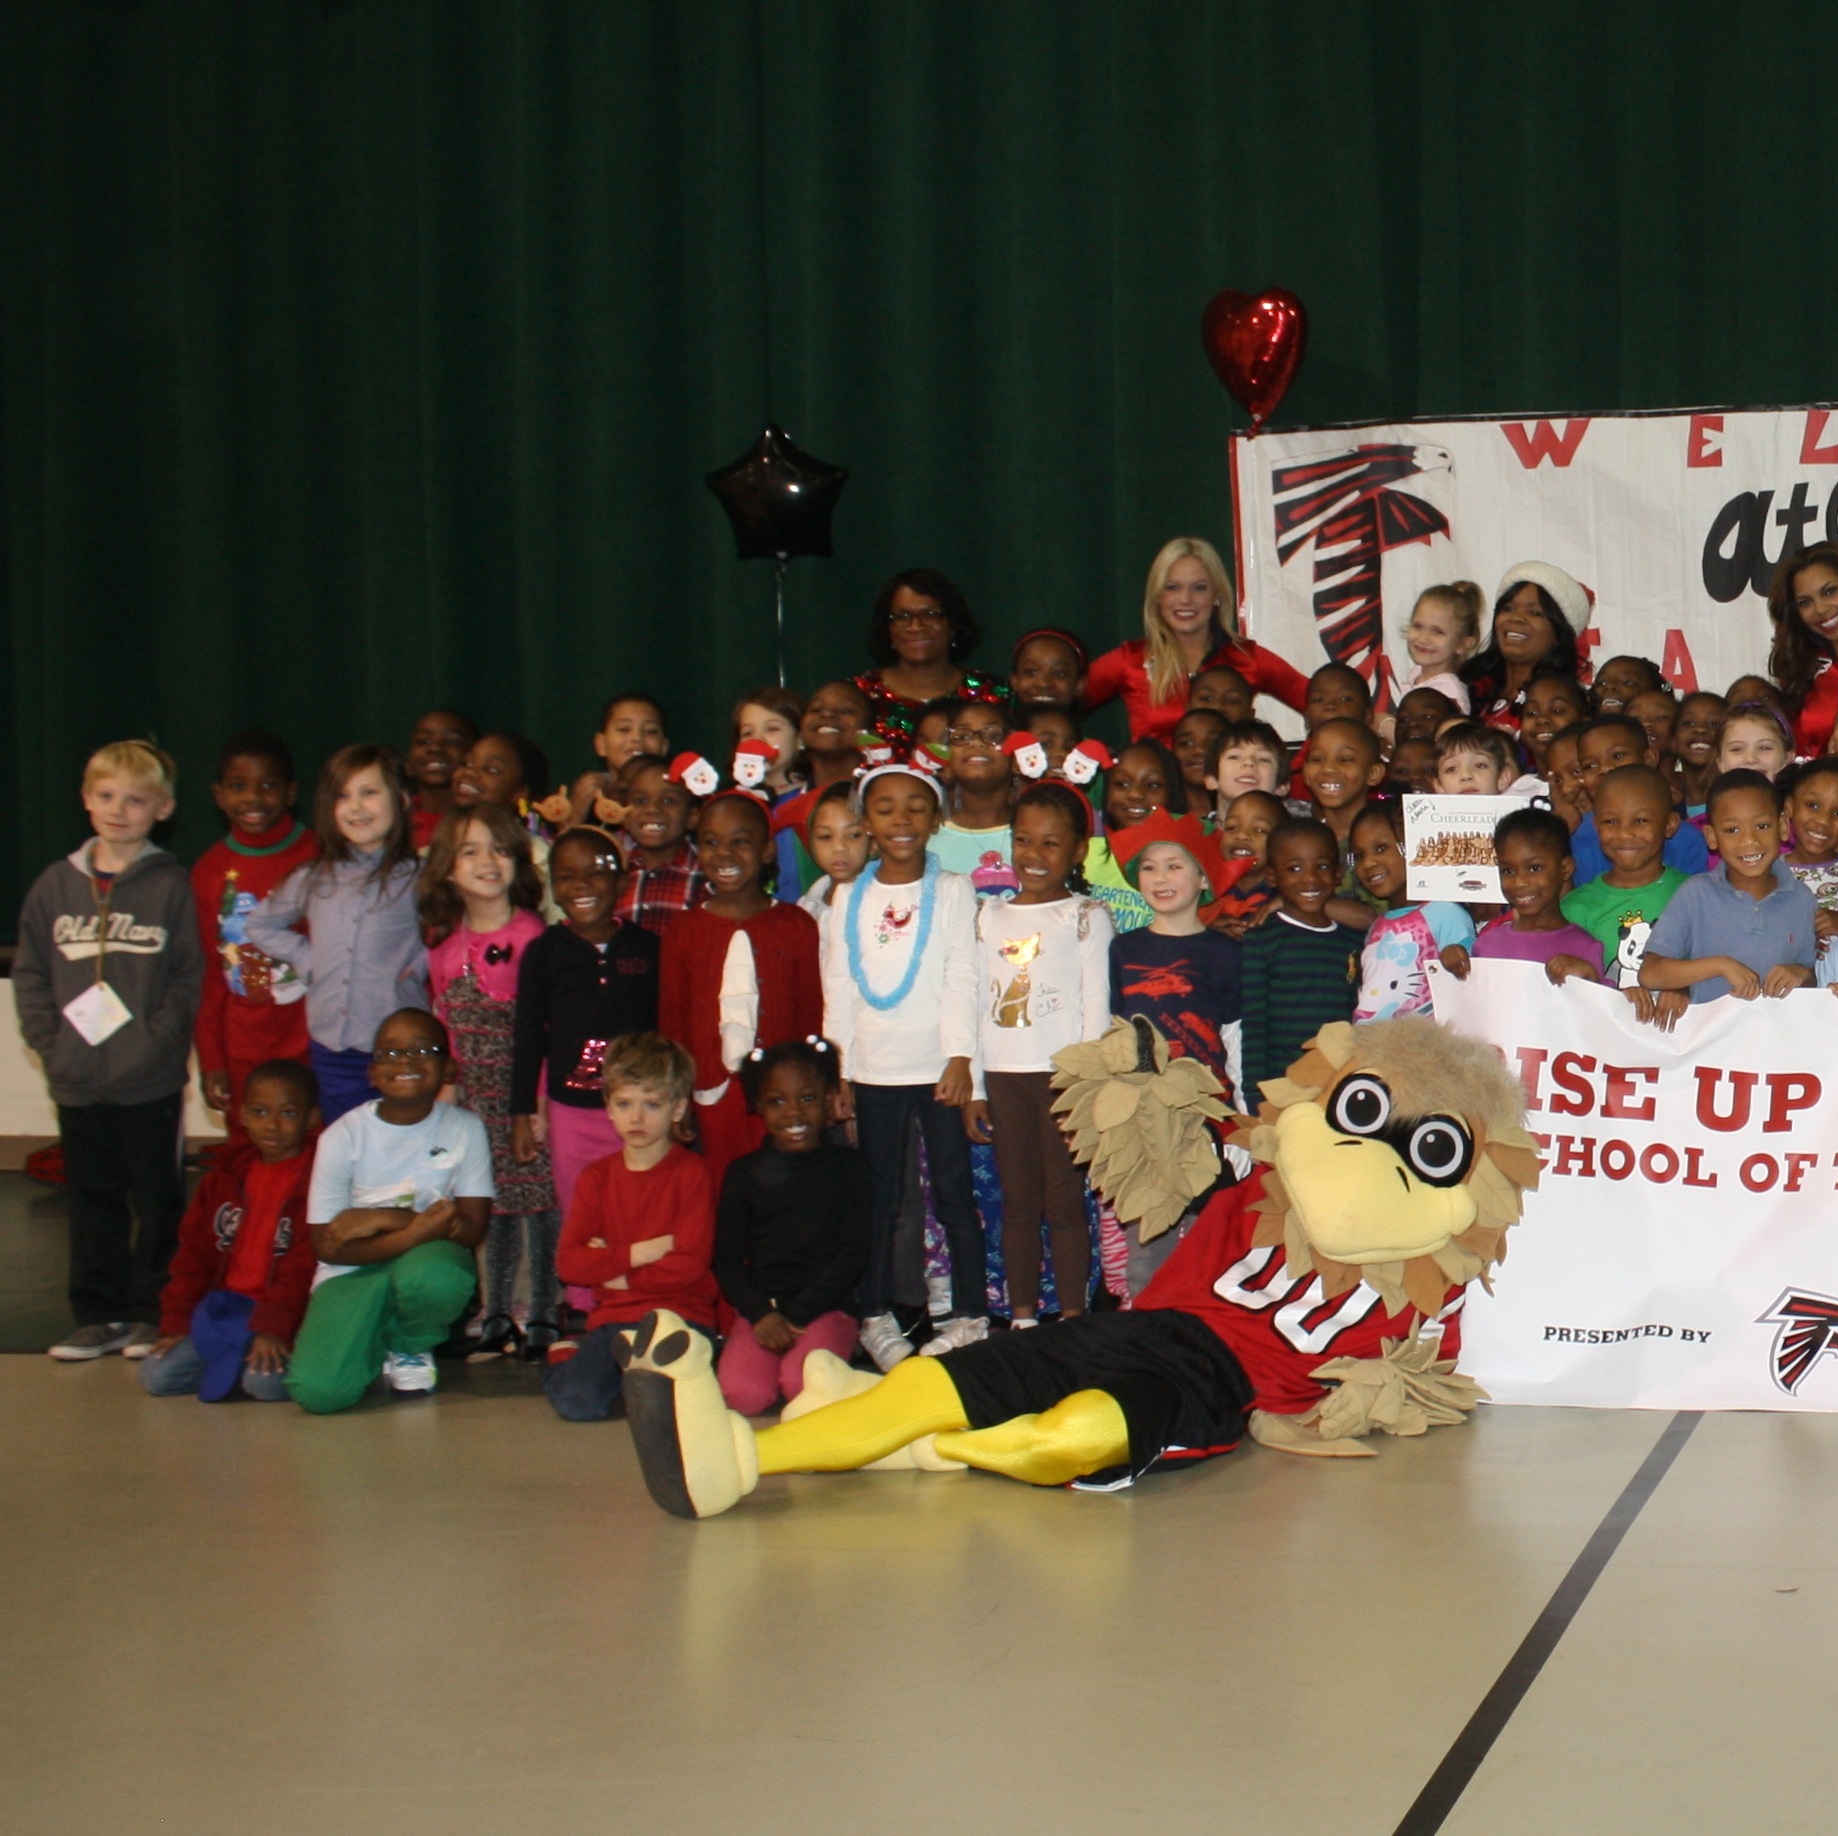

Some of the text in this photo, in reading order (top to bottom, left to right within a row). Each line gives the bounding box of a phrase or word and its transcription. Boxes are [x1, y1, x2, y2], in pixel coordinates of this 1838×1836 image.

[54, 914, 100, 943] Old
[1693, 1065, 1823, 1133] UP
[1739, 1152, 1819, 1193] OF
[1542, 1323, 1712, 1344] PRESENTED BY
